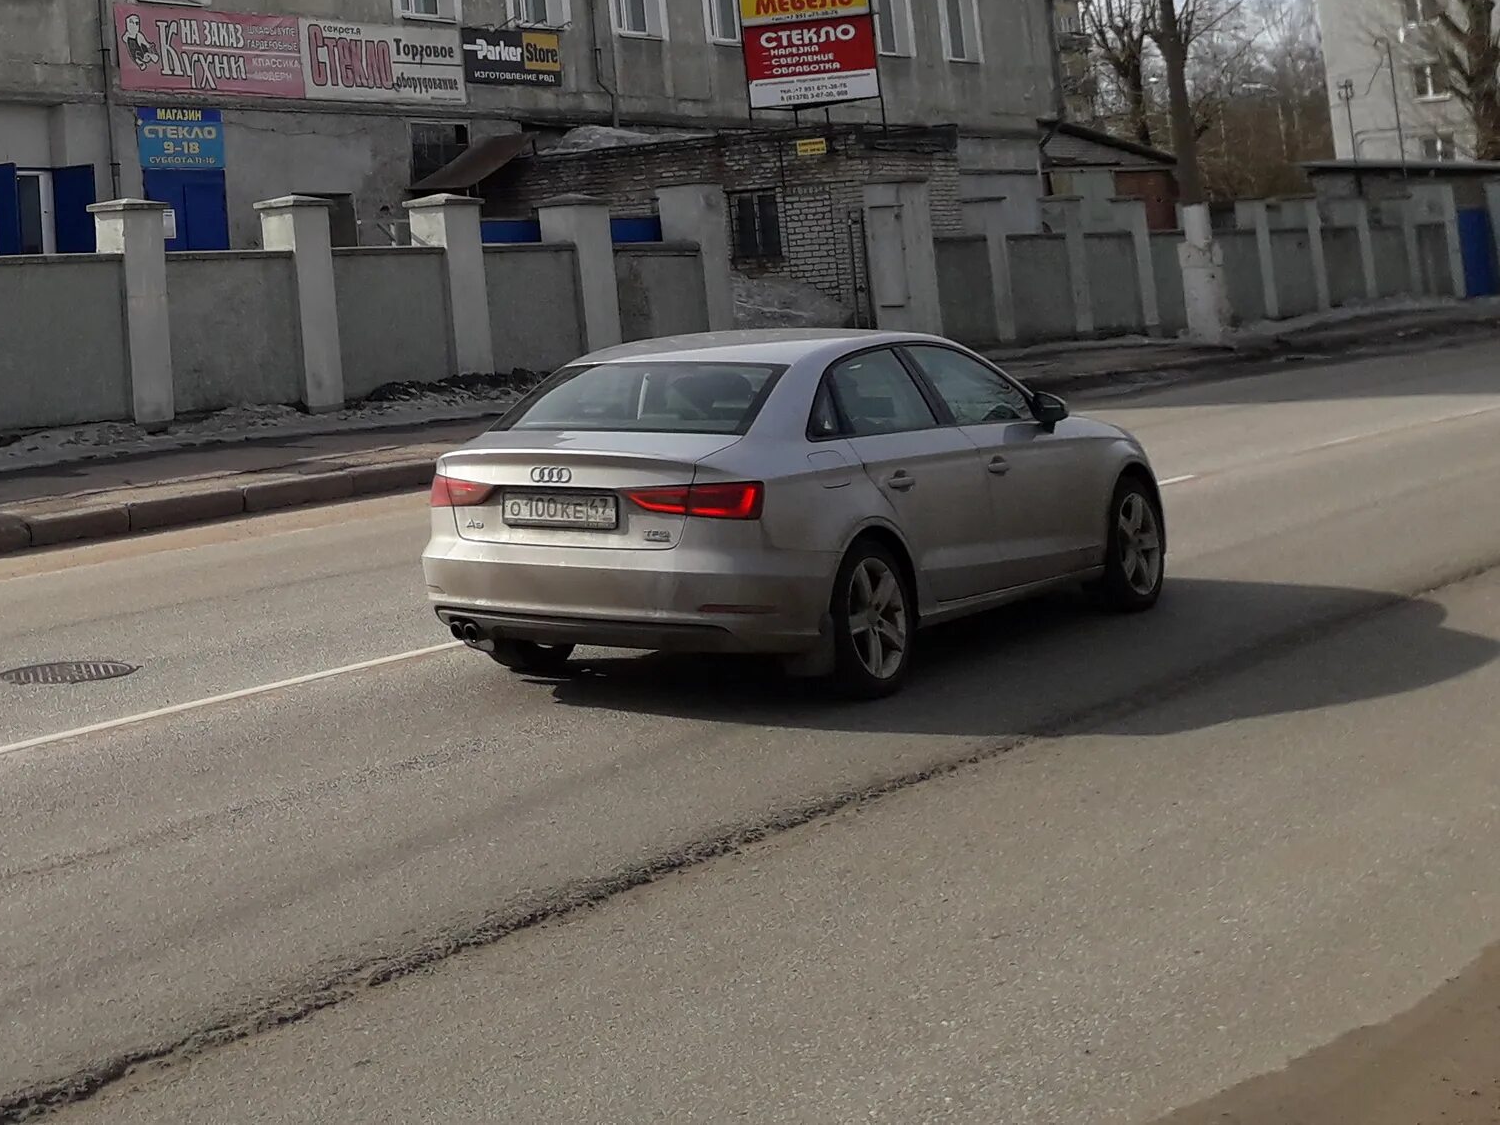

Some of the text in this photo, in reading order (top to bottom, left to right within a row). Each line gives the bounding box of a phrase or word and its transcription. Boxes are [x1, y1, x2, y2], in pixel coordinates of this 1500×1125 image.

[179, 18, 245, 49] НА ЗАКАЗ
[760, 24, 856, 48] СТЕКЛО
[393, 38, 455, 64] Торговое
[463, 39, 558, 63] Parker Store
[251, 57, 301, 68] КЛАССИКА
[394, 72, 460, 94] оборудование
[474, 70, 555, 83] ИЗГОТОВЛЕНИЕ РВД
[156, 108, 202, 121] МАГАЗИН
[143, 126, 217, 139] СТЕКЛО
[163, 141, 200, 154] 9-18
[149, 156, 194, 164] СУББОТА
